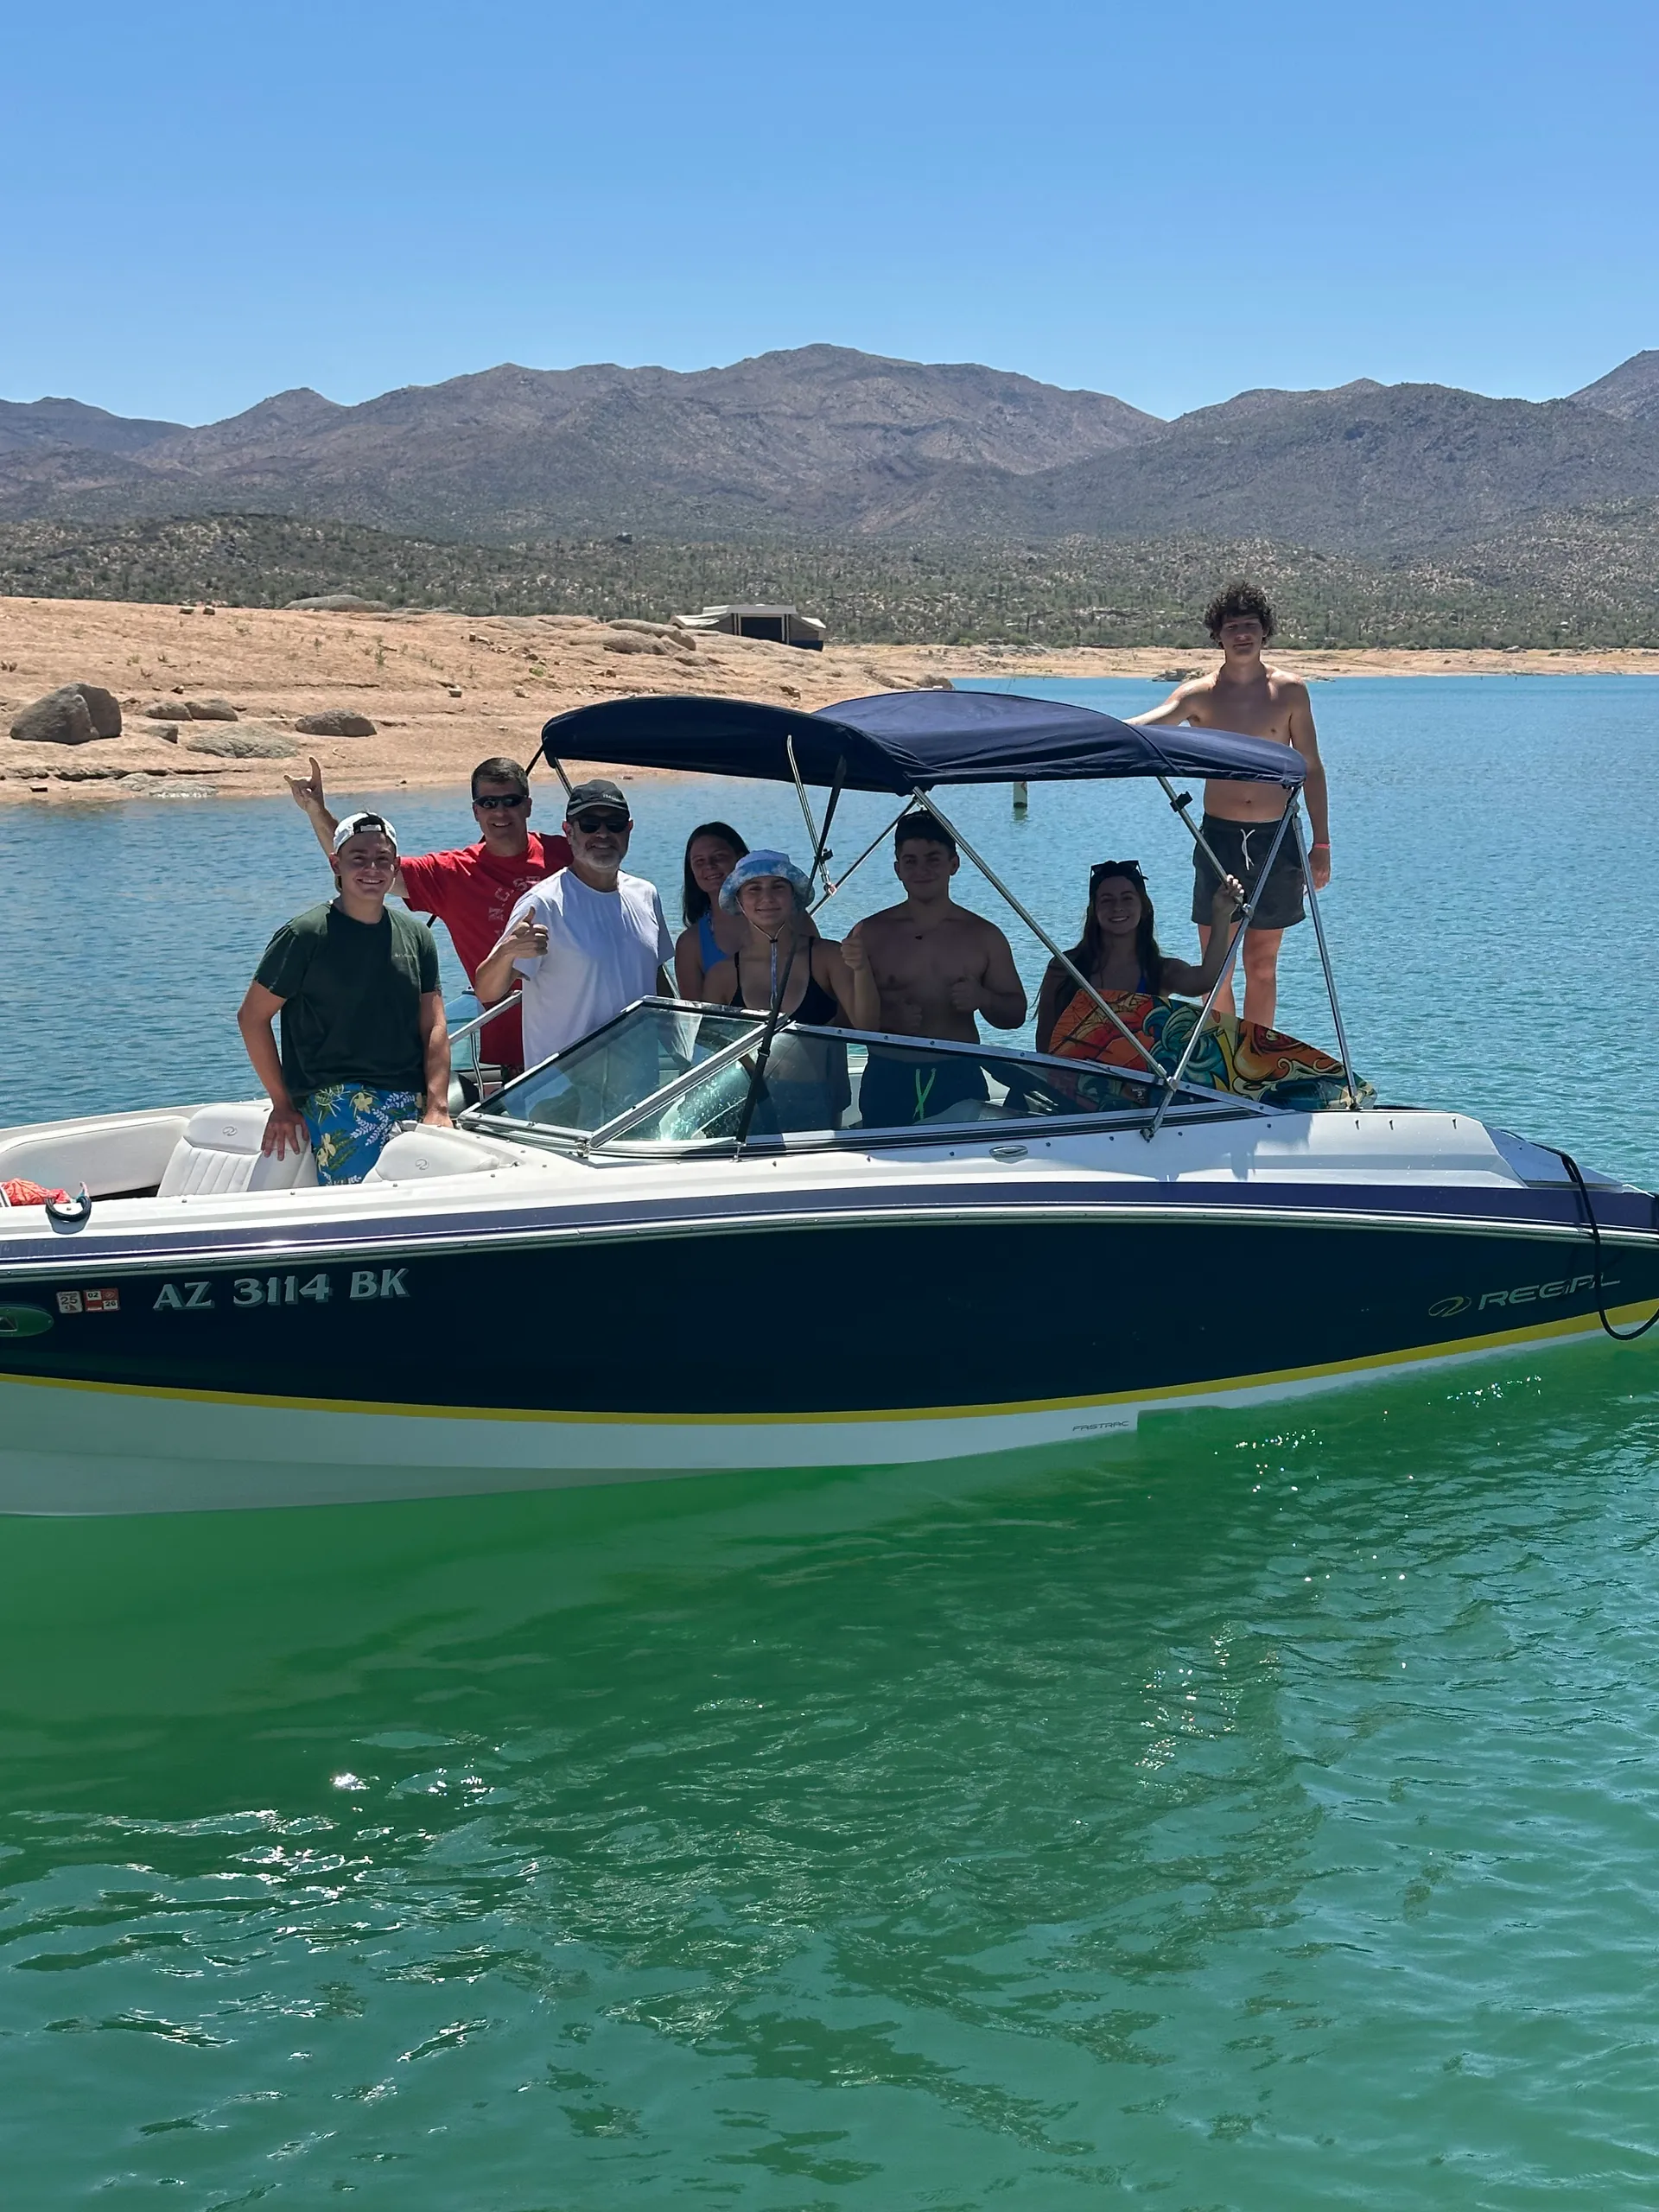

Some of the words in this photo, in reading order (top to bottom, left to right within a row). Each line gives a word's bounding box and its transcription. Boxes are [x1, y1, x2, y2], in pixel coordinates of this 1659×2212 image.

[153, 1281, 214, 1311] AZ
[232, 1273, 330, 1307] 3114
[350, 1268, 410, 1299] BK
[60, 1296, 79, 1305] 25
[1072, 1421, 1130, 1432] FASTRAC
